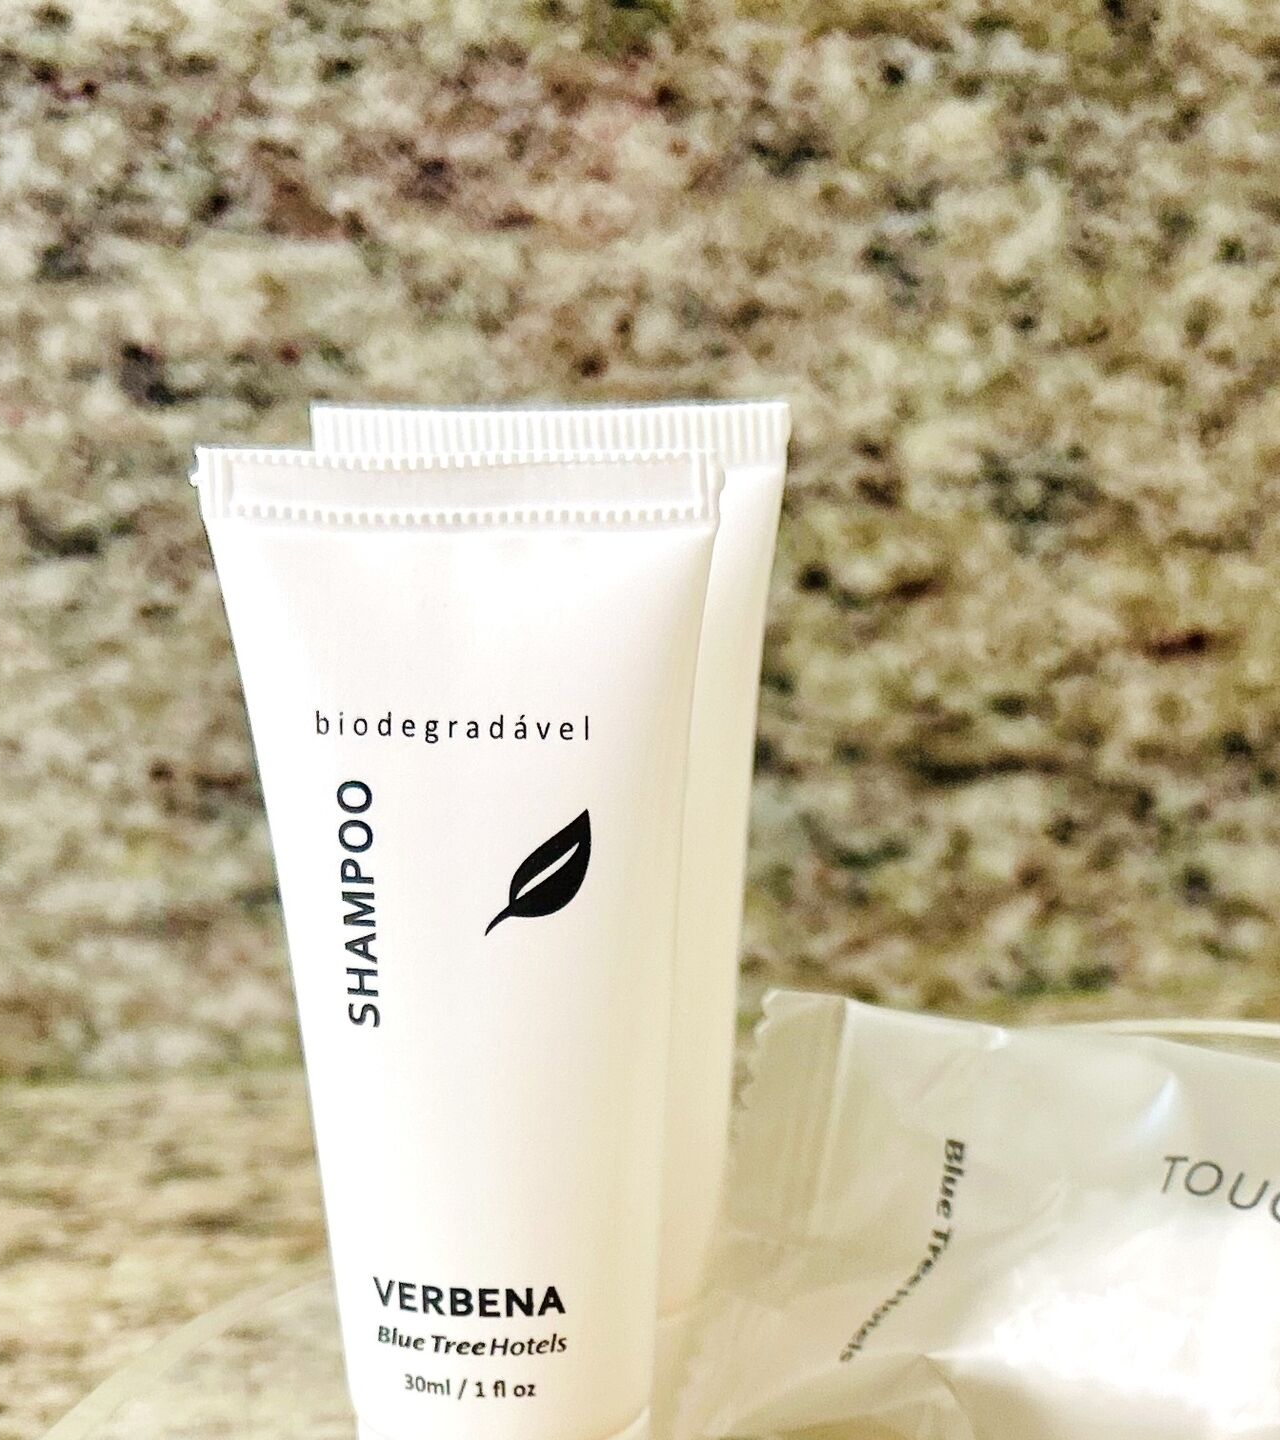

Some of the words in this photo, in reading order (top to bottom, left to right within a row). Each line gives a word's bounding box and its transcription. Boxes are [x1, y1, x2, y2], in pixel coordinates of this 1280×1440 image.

[316, 711, 591, 744] biodegradável
[335, 779, 380, 1029] SHAMPOO
[936, 1138, 966, 1219] Blue
[372, 1276, 566, 1319] VERBENA
[377, 1325, 426, 1352] Blue
[431, 1334, 487, 1356] Tree
[490, 1333, 568, 1357] Hotels
[404, 1373, 451, 1397] 30ml
[475, 1381, 485, 1398] 1
[493, 1380, 507, 1398] fl
[513, 1383, 537, 1398] oz
